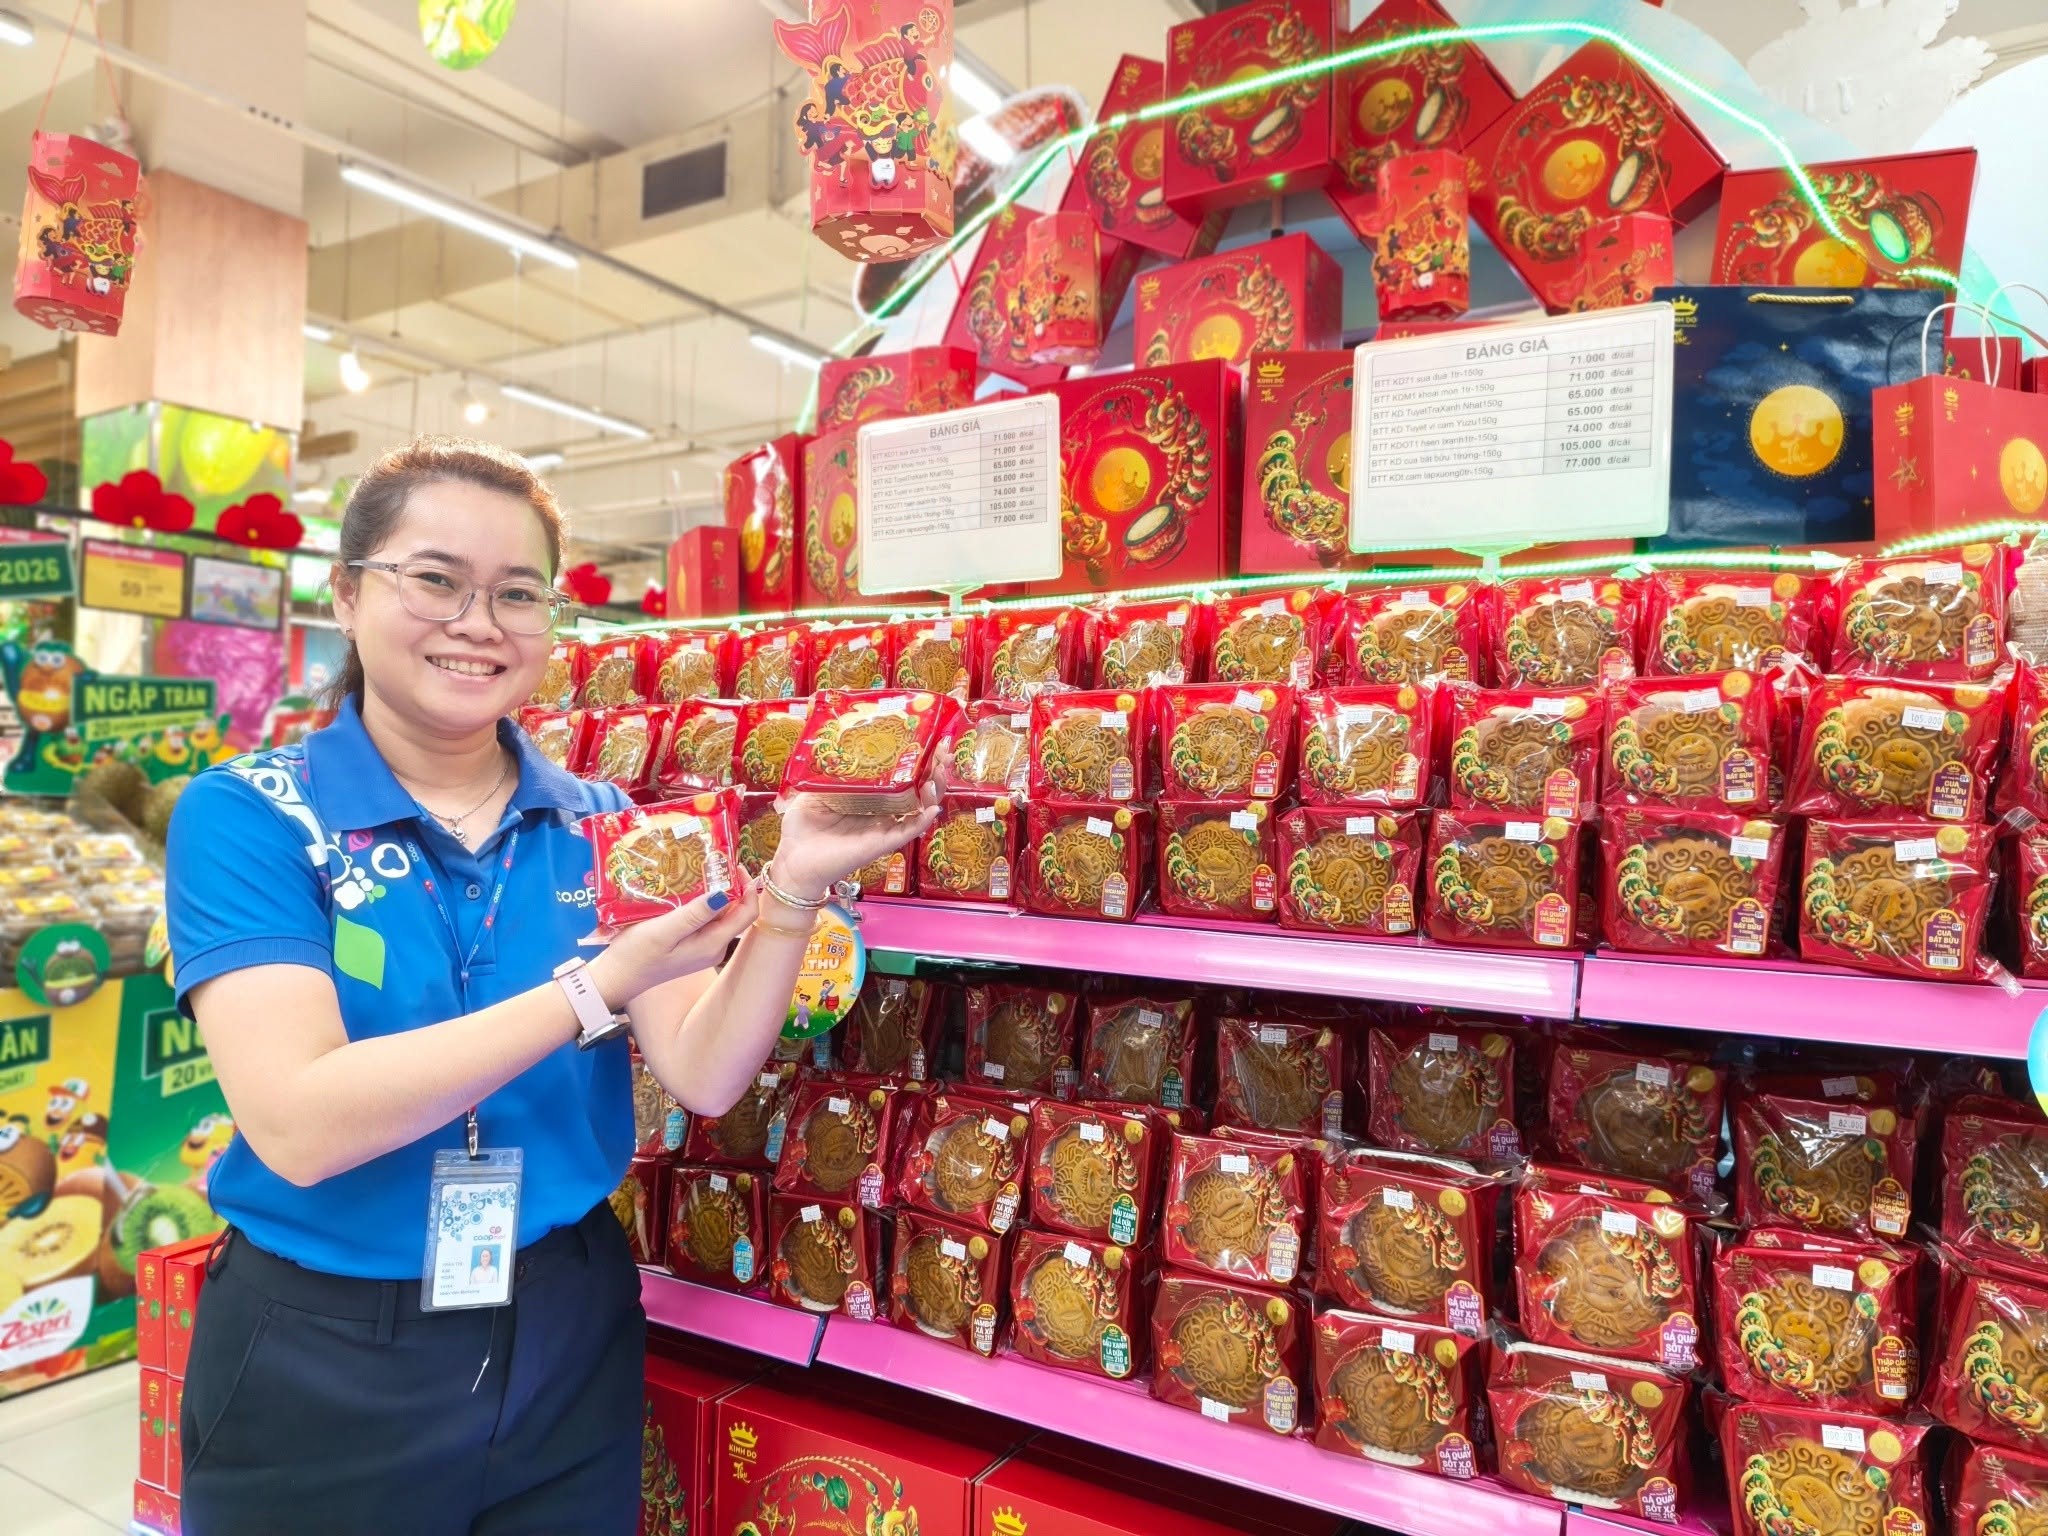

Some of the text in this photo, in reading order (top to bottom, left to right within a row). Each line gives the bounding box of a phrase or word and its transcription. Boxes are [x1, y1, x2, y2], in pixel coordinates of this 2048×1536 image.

[1570, 353, 1605, 364] 71.000
[1570, 370, 1604, 382] 71.000
[1569, 388, 1604, 399] 65.000
[1568, 406, 1603, 416] 65.000
[1567, 423, 1602, 432] 74.000
[1560, 440, 1601, 450] 105.000
[1565, 457, 1601, 467] 77.000
[0, 557, 61, 584] 2026
[84, 680, 207, 714] NGẬP TRÀN
[1911, 713, 1941, 724] 105.000
[1944, 780, 1959, 789] CUA
[1936, 785, 1966, 795] BÁT BỬU
[1733, 921, 1747, 929] BÁT
[1741, 916, 1754, 924] CUA
[1937, 929, 1952, 938] CUA
[1944, 935, 1959, 944] BỬU
[827, 943, 845, 957] 16%
[807, 958, 840, 970] THU
[172, 1065, 195, 1090] 20
[1838, 1119, 1863, 1129] 82.000
[1124, 1209, 1136, 1219] XANH
[1283, 1251, 1294, 1260] SEN
[1448, 1297, 1479, 1310] GÀ QUAY
[1, 1310, 72, 1350] Zespri
[1664, 1332, 1697, 1344] GÀ QUAY
[1113, 1341, 1127, 1350] XANH
[1666, 1341, 1683, 1352] SỐT
[1900, 1350, 1906, 1358] 41
[1877, 1358, 1894, 1366] THẬP
[1877, 1366, 1888, 1375] LẠP
[1281, 1403, 1292, 1411] SEN
[729, 1444, 757, 1461] KINH DO
[1451, 1451, 1471, 1460] QUAY
[1655, 1495, 1675, 1504] QUAY
[1646, 1504, 1661, 1512] SỐT
